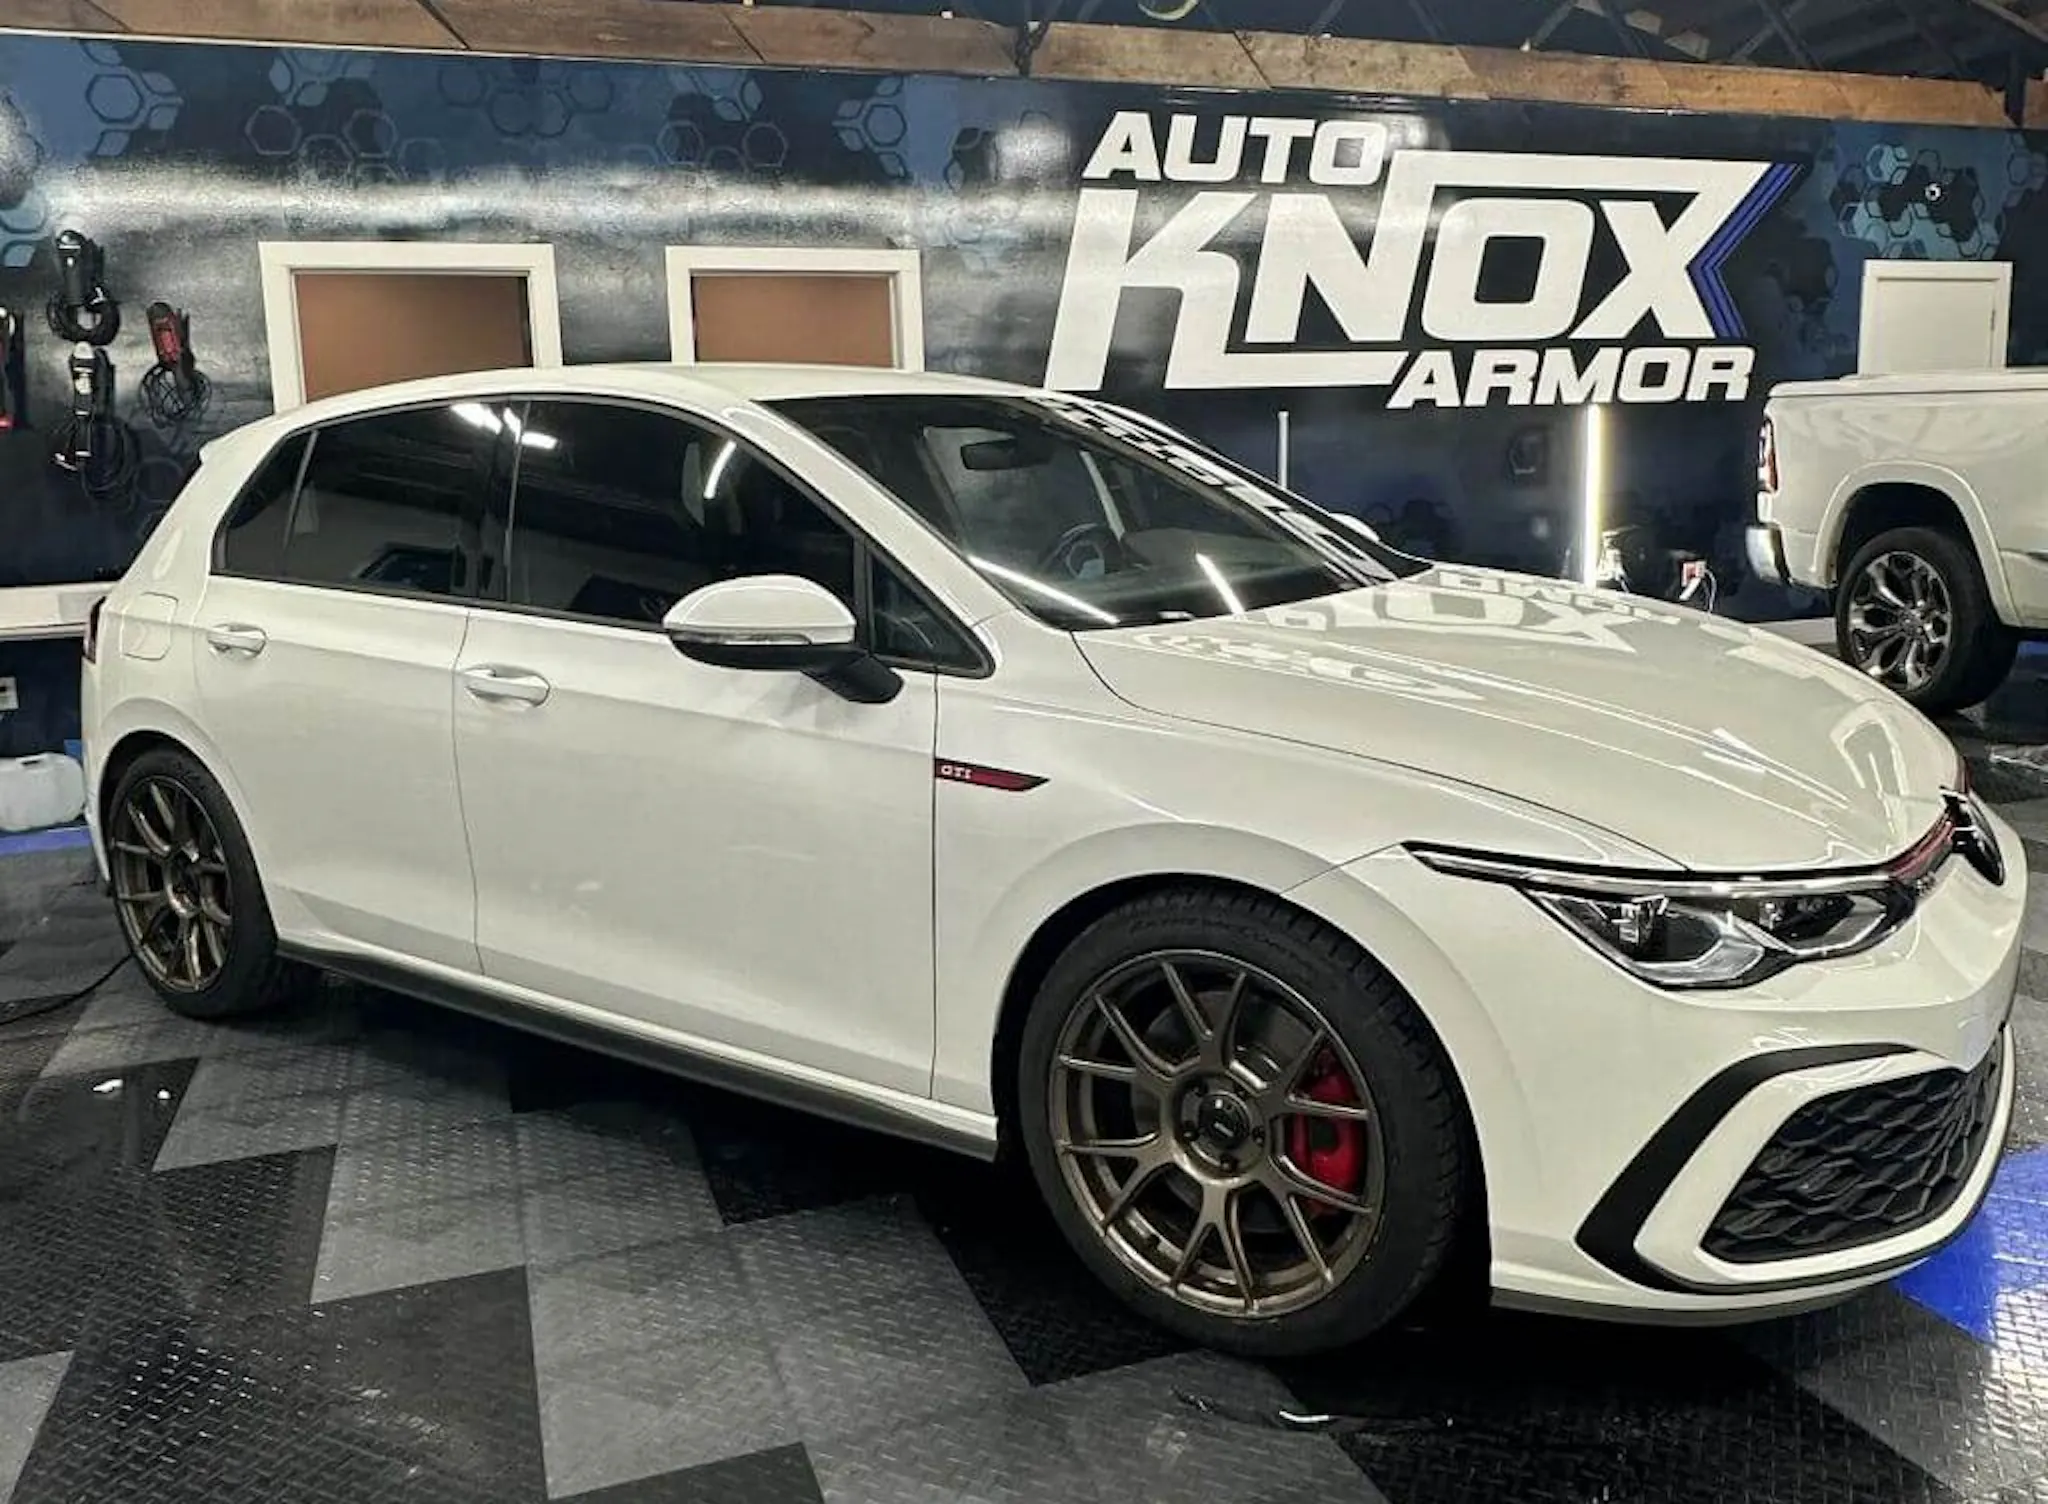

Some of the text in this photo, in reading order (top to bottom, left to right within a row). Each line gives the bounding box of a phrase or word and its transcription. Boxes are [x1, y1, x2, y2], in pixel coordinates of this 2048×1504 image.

[1083, 111, 1387, 185] AUTO
[1044, 150, 1772, 391] KNOX
[1386, 347, 1754, 408] ARMOR
[941, 764, 972, 779] GTI
